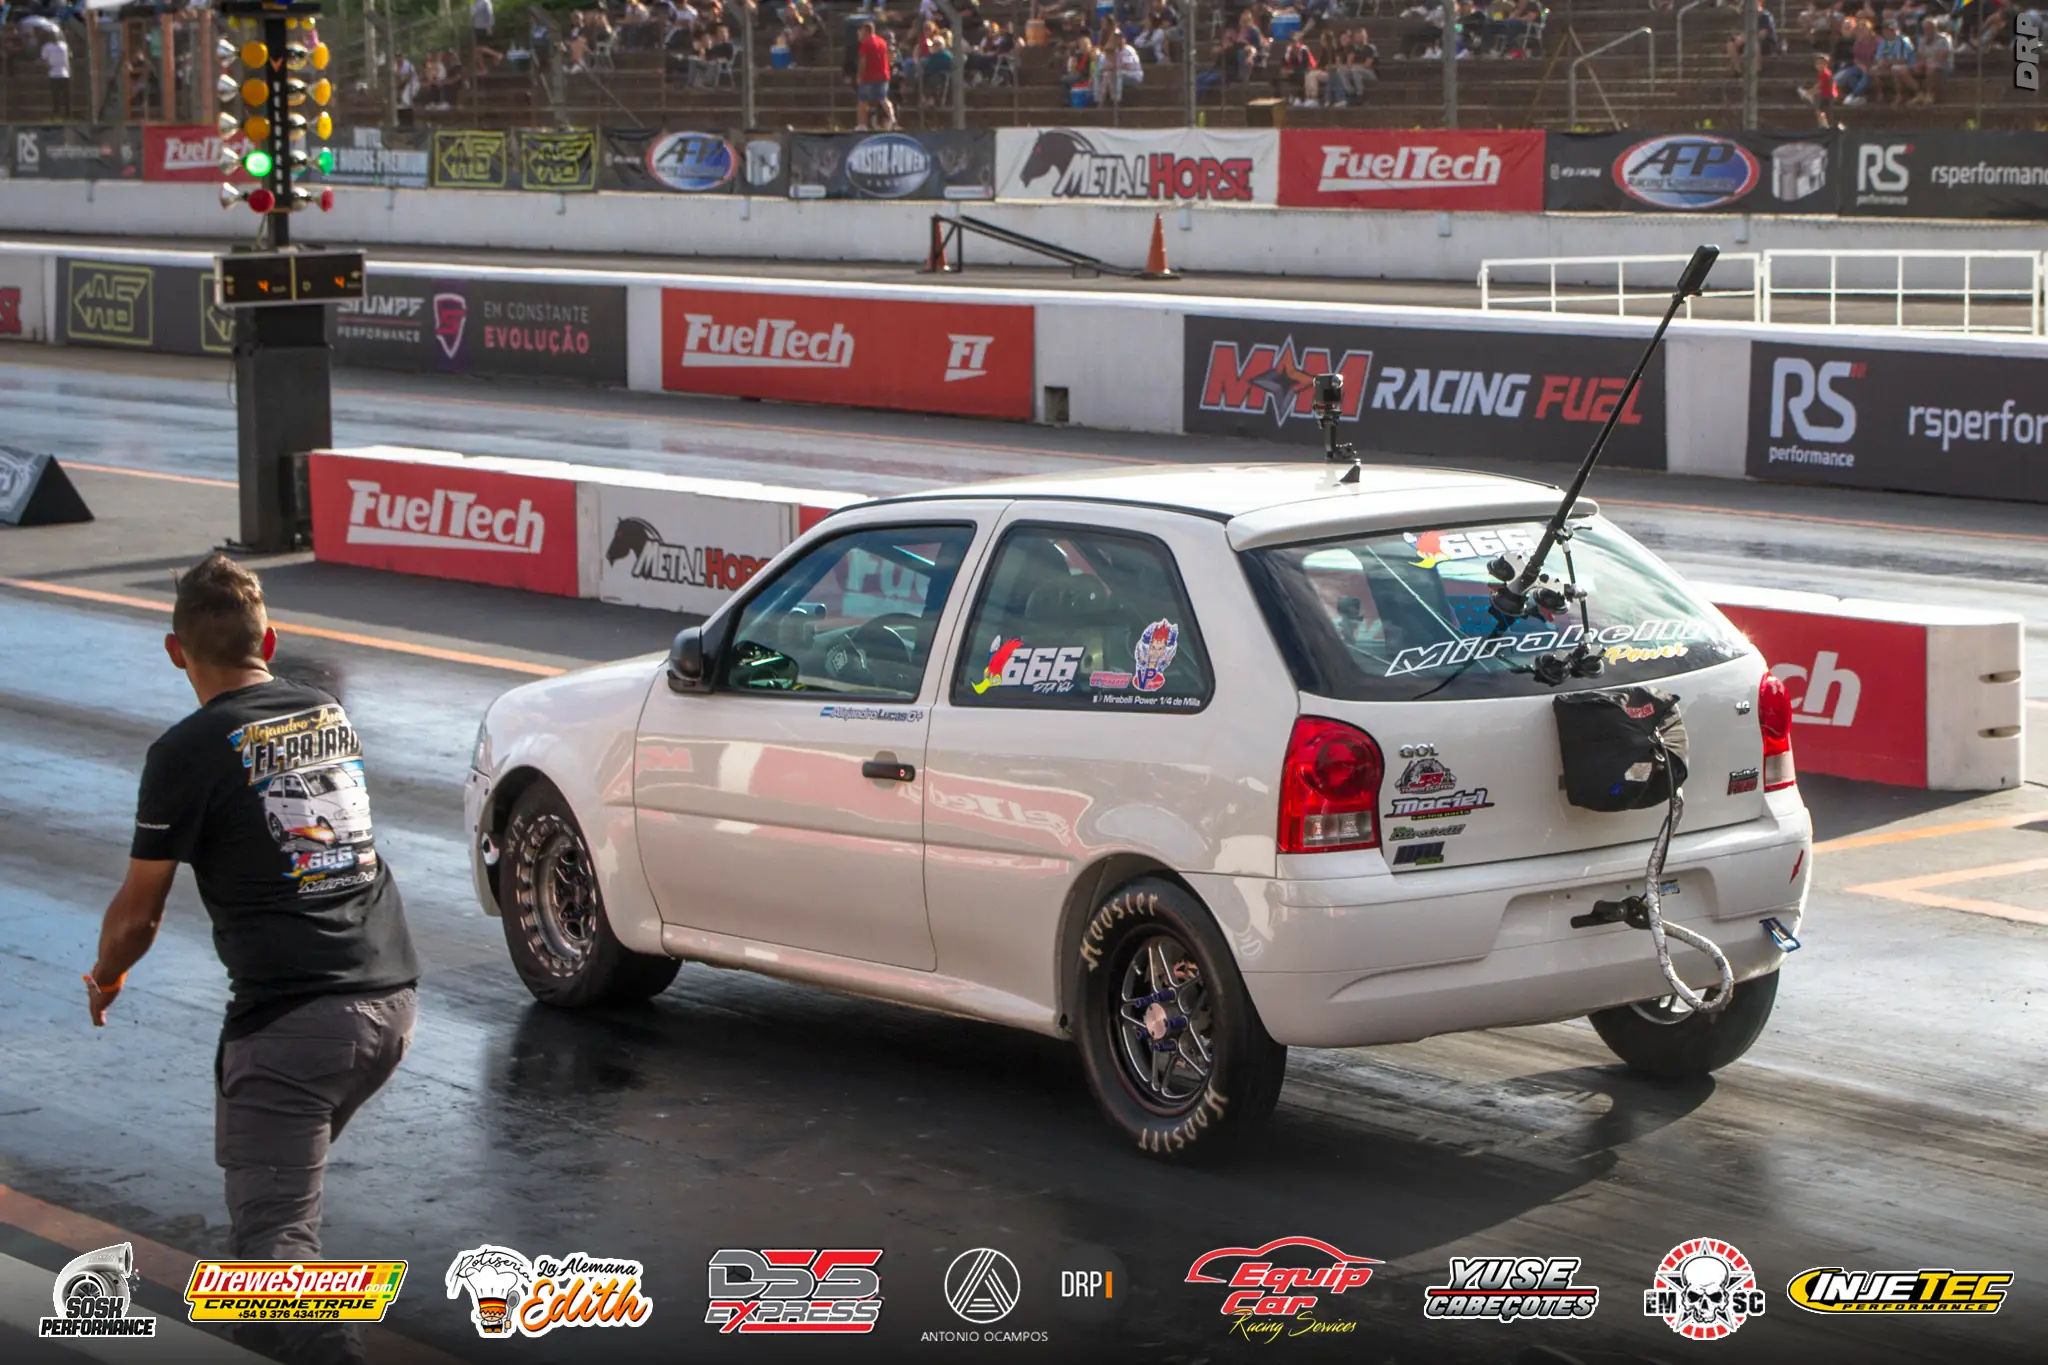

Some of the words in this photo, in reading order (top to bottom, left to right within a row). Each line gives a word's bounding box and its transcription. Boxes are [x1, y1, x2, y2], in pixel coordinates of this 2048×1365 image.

[163, 136, 256, 169] FuelTch
[1318, 145, 1501, 192] FuelTech
[1857, 144, 1909, 192] RS
[507, 303, 590, 324] CONSTANTE
[484, 324, 590, 356] EVOLUÇÃO
[682, 313, 855, 368] FuelTech
[945, 334, 995, 370] FT
[1372, 367, 1531, 418] RACING
[1534, 375, 1644, 425] FUEL
[1770, 357, 1857, 443] RS
[1768, 445, 1855, 468] performance
[346, 480, 545, 554] FuelTech
[1001, 646, 1086, 686] 666
[1603, 641, 1689, 667] Power
[1134, 695, 1158, 706] Power
[1160, 696, 1172, 706] 1/4
[1399, 743, 1439, 759] GOL
